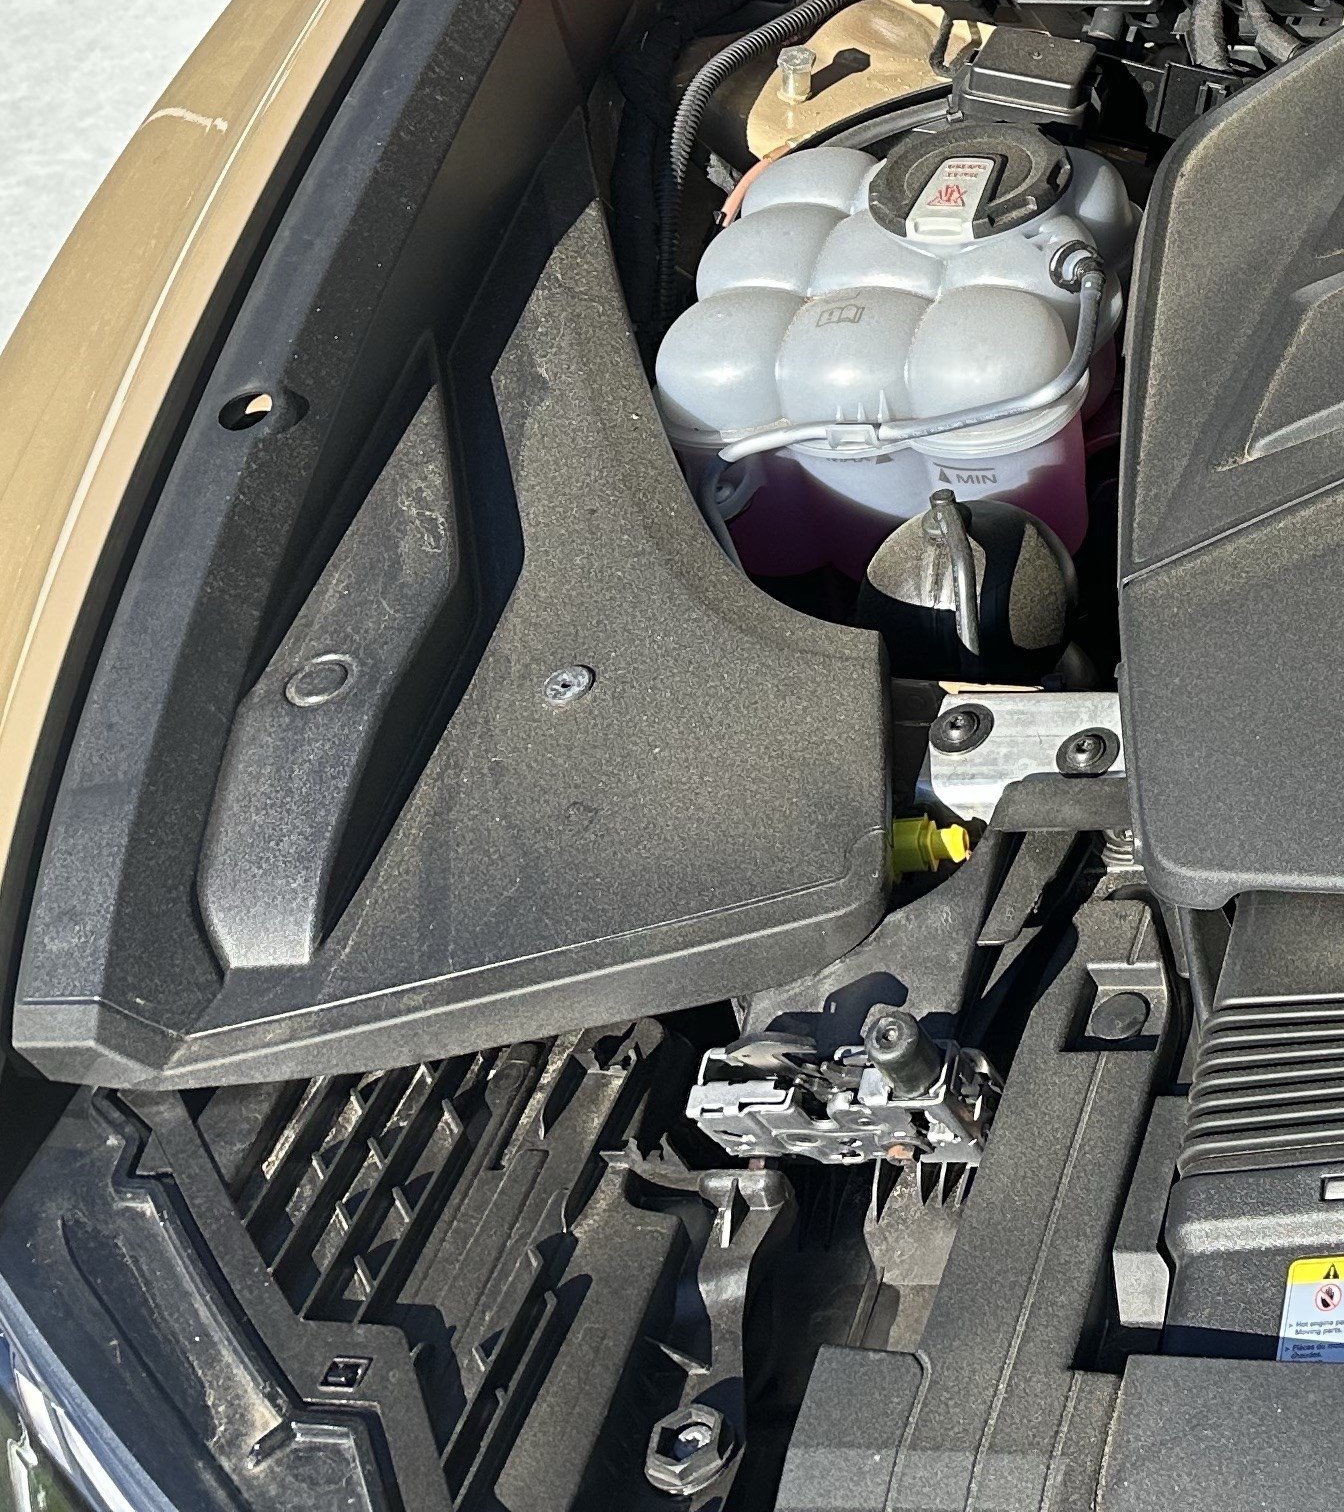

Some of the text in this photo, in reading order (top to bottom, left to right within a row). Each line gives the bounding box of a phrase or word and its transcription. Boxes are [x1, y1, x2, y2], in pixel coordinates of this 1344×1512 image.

[955, 473, 998, 485] MIN
[1309, 1319, 1334, 1329] engine
[1294, 1328, 1322, 1337] Moving
